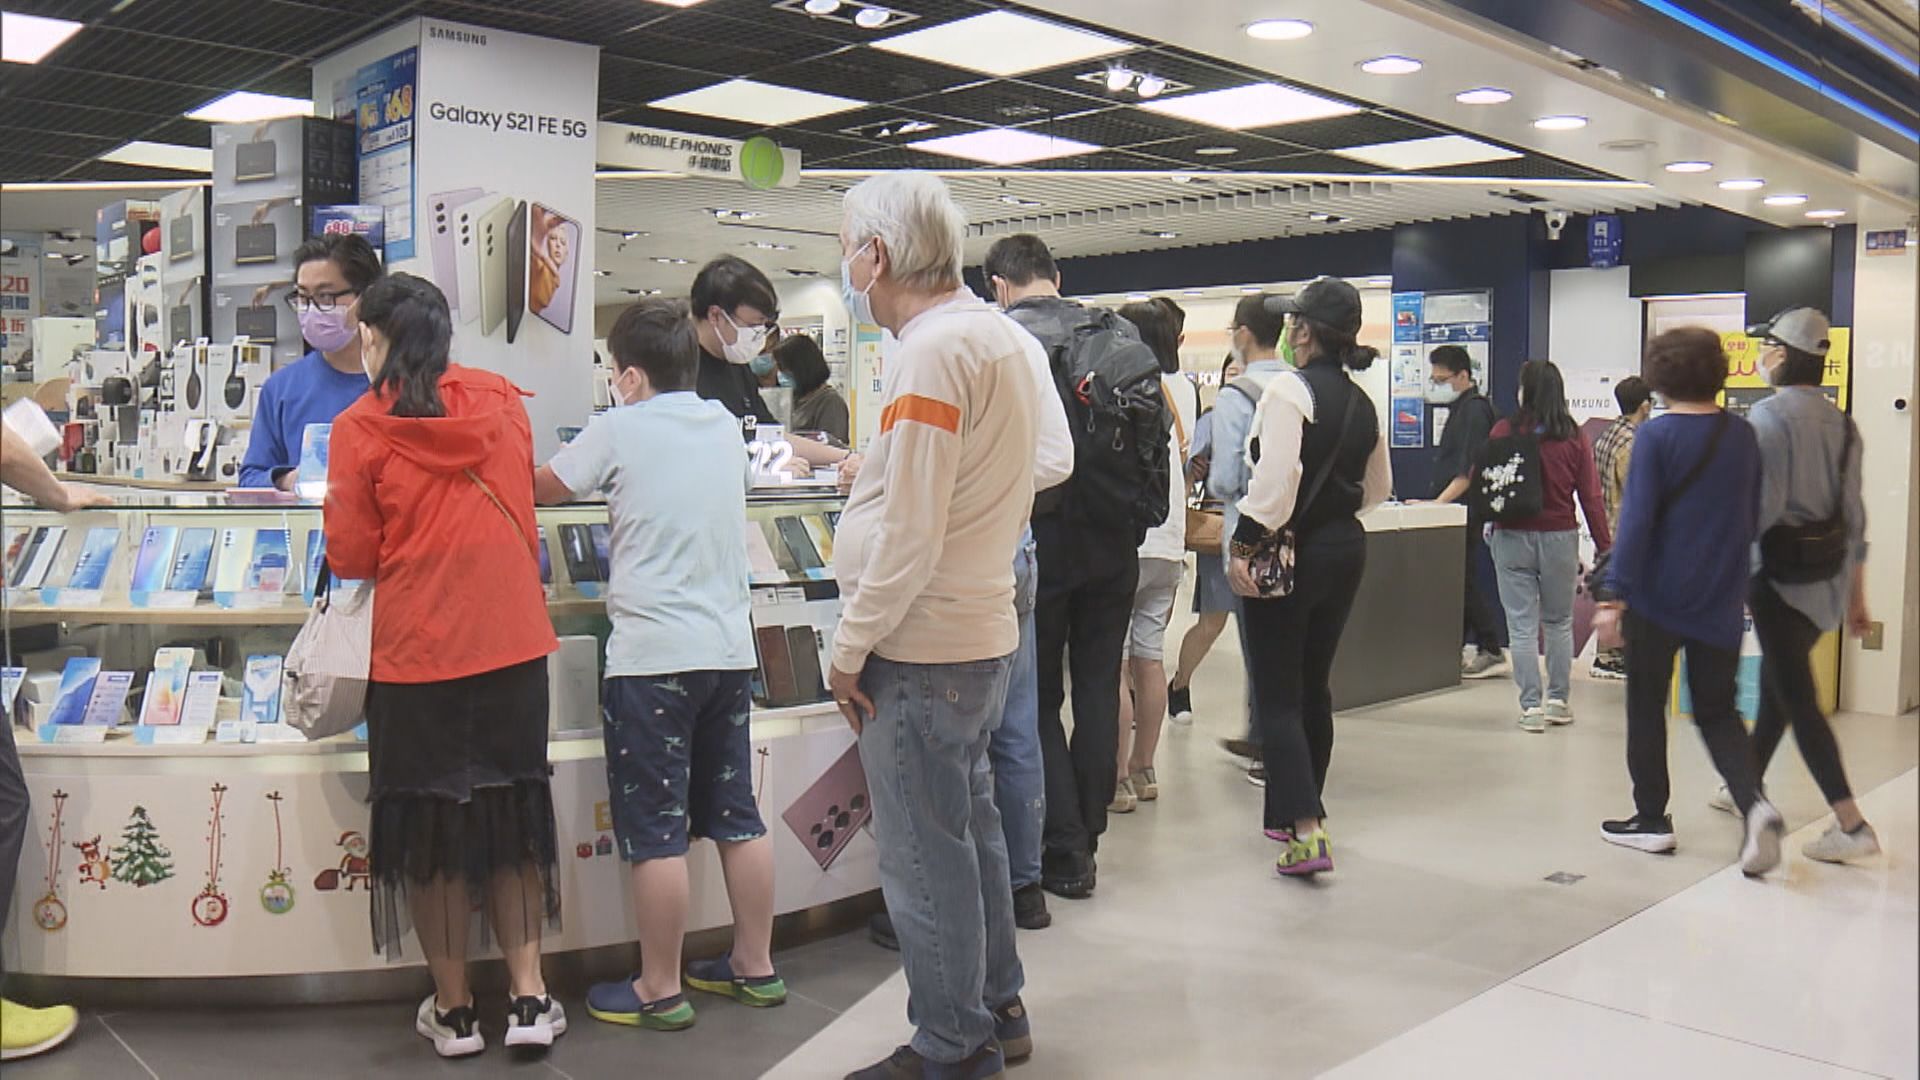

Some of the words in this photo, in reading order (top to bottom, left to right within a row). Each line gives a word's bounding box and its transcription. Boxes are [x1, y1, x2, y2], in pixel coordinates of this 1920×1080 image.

[429, 26, 487, 46] SAMSUNG
[430, 102, 502, 132] Galaxy
[506, 112, 534, 132] S21
[538, 117, 558, 135] FE
[562, 119, 588, 138] 5G
[628, 131, 679, 150] MOBILE
[680, 138, 733, 156] PHONES
